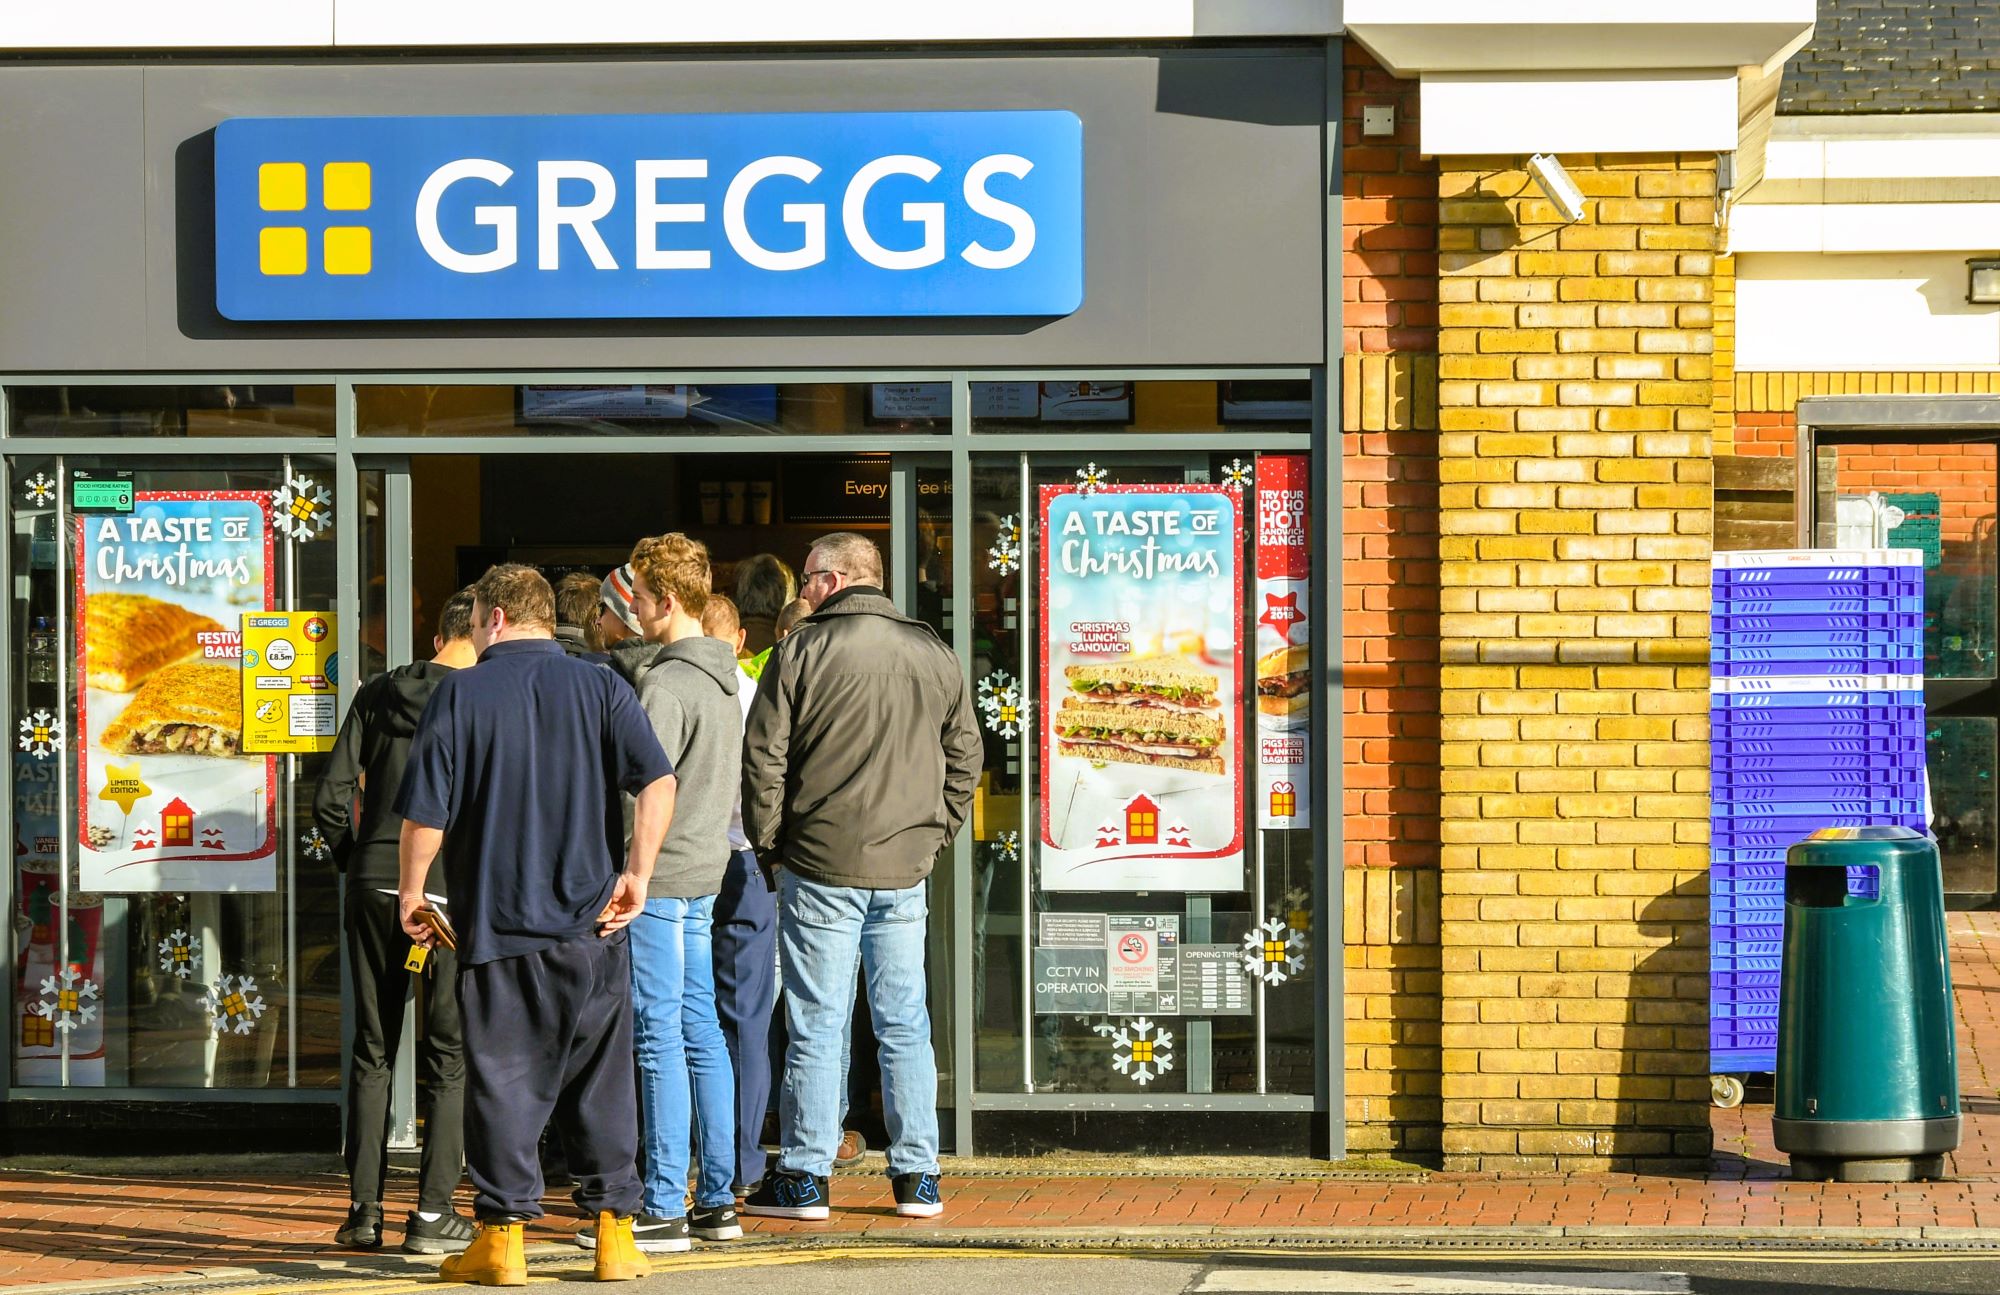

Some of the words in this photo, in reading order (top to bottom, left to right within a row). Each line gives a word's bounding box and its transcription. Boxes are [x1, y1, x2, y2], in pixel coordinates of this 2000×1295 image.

[415, 154, 1036, 273] GREGGS
[845, 480, 887, 498] Every
[121, 495, 127, 503] 5
[1260, 490, 1280, 499] TRY
[1281, 490, 1304, 499] OUR
[1260, 500, 1281, 511] HO
[1283, 500, 1304, 511] HO
[1062, 511, 1086, 535] A
[1092, 511, 1181, 535] TASTE
[1191, 515, 1218, 531] OF
[1260, 511, 1304, 528] HOT
[97, 517, 120, 542] A
[126, 517, 212, 542] TASTE
[223, 522, 248, 537] OF
[1260, 535, 1304, 545] RANGE
[1061, 536, 1220, 580] Christmas
[96, 543, 250, 586] Christmas
[1270, 611, 1294, 620] 2018
[1071, 623, 1130, 632] CHRISTMAS
[197, 632, 241, 644] FESTIV
[1083, 633, 1118, 642] LUNCH
[204, 646, 242, 658] BAKE
[1071, 643, 1130, 652] SANDWICH
[269, 653, 292, 661] £8.5m
[1263, 740, 1283, 748] PIGS
[35, 844, 59, 852] LATT
[1046, 966, 1082, 977] CCTV
[1085, 966, 1099, 977] IN
[1036, 983, 1108, 993] OPERATION
